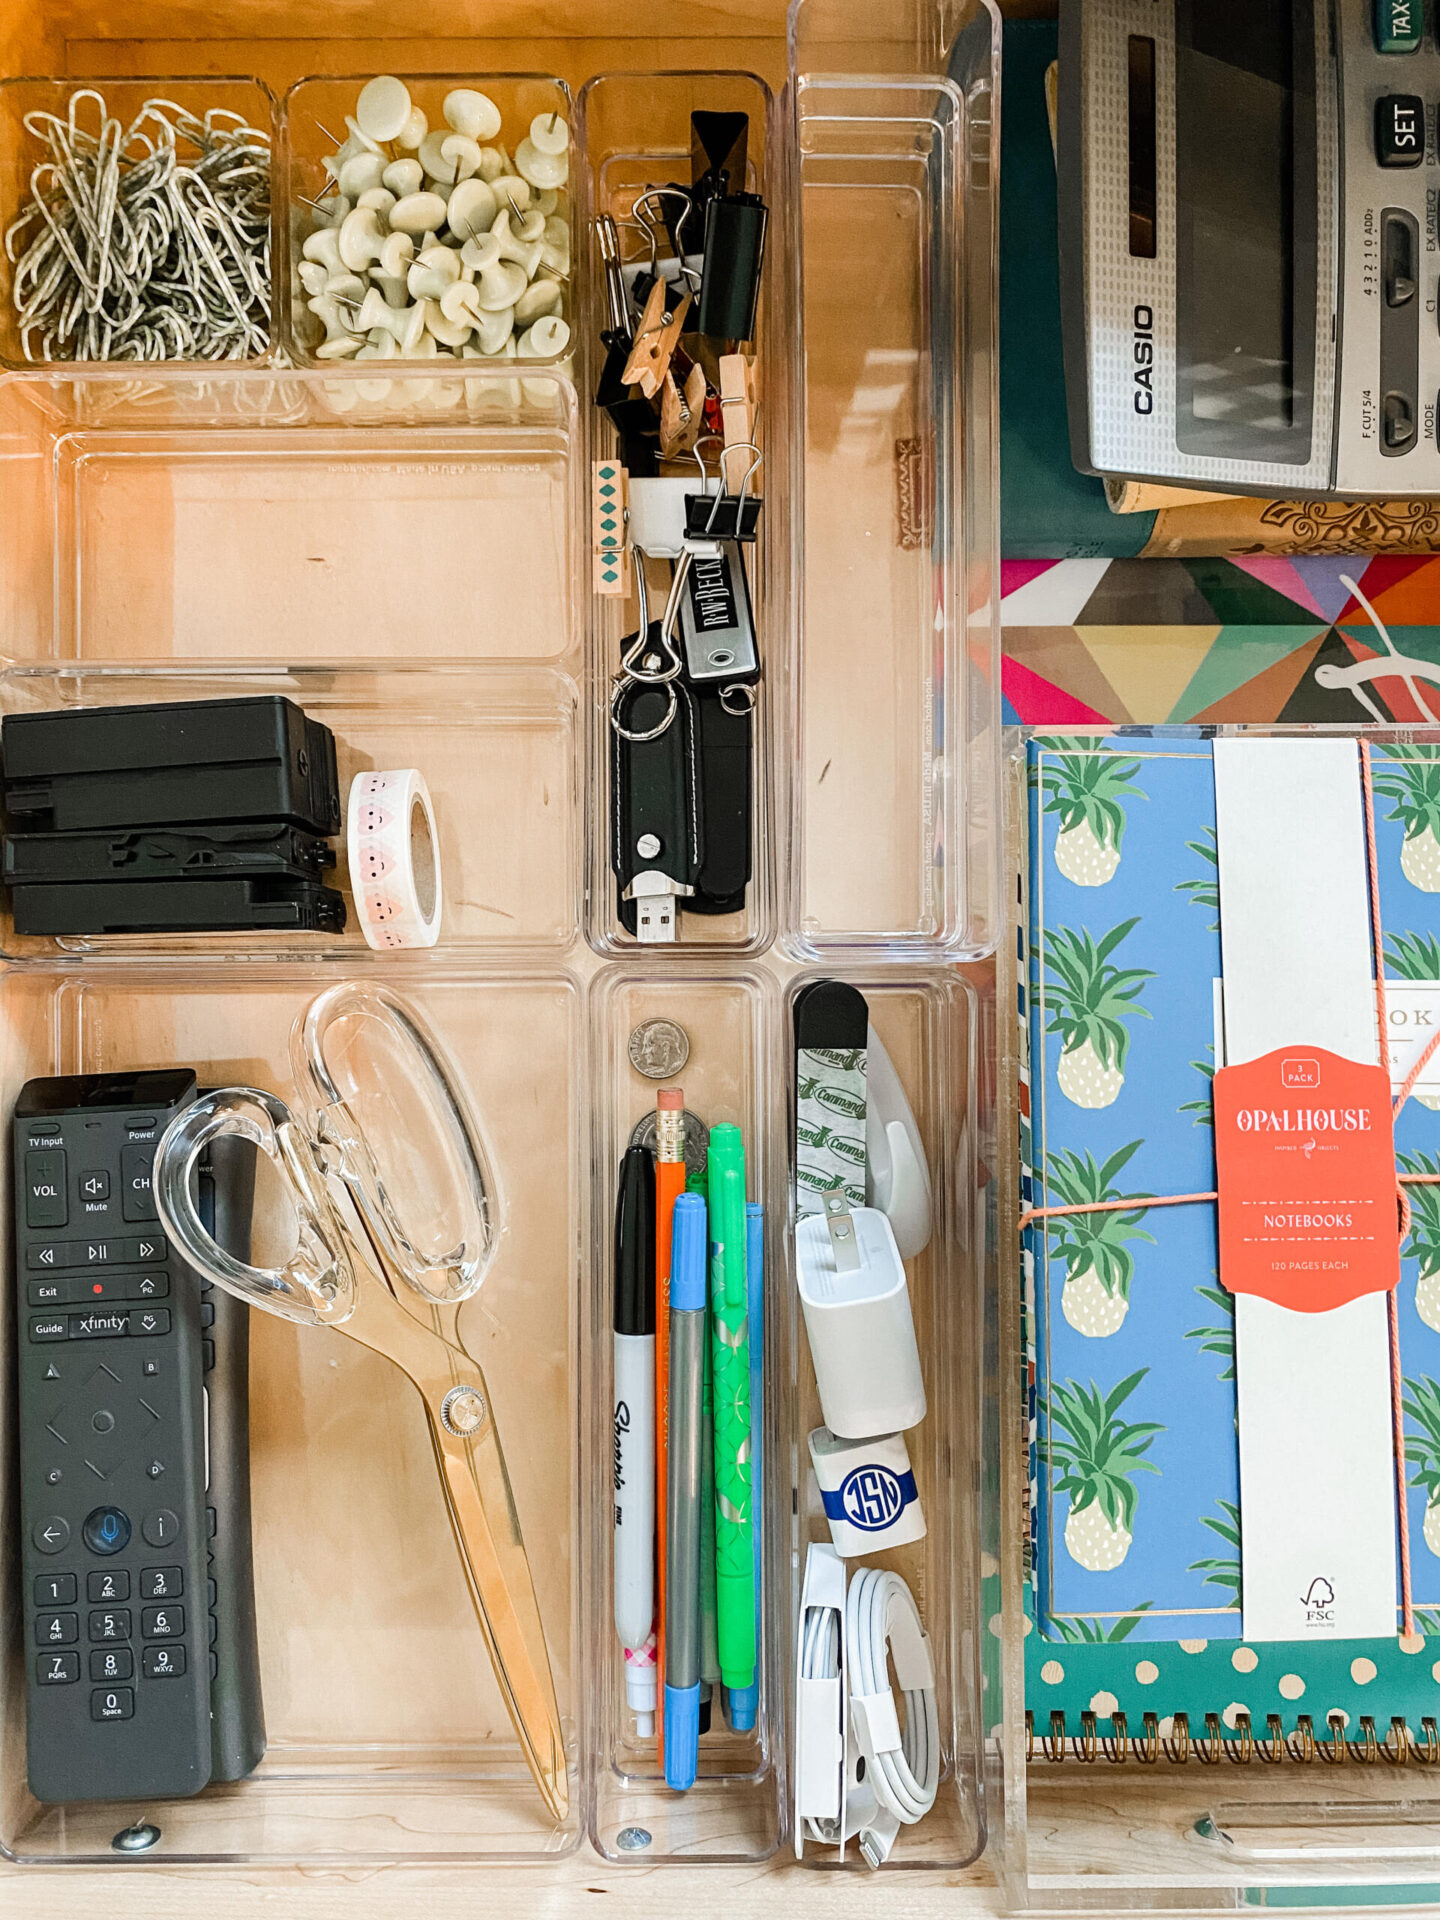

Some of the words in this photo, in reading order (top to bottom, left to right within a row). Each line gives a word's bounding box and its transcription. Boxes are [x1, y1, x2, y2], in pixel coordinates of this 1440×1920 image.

[1392, 0, 1411, 37] TAX
[1394, 104, 1416, 147] SET
[1425, 188, 1436, 233] RATE/C2
[1425, 234, 1436, 252] EX
[1425, 299, 1436, 313] C1
[1134, 305, 1153, 415] CASIO
[1362, 389, 1371, 409] 5/4
[1362, 410, 1371, 431] CUT
[1424, 403, 1435, 439] MODE
[1288, 1072, 1314, 1082] PACK
[817, 1088, 864, 1113] Command
[1236, 1108, 1372, 1132] OPALHOUSE
[29, 1138, 41, 1147] TV
[41, 1137, 64, 1147] Input
[129, 1130, 155, 1140] Power
[133, 1178, 150, 1189] CH
[33, 1186, 58, 1197] VOL
[86, 1202, 108, 1212] Mute
[1263, 1213, 1353, 1228] NOTEBOOKS
[1271, 1261, 1287, 1271] 120
[1289, 1261, 1320, 1270] PAGES
[1322, 1261, 1349, 1270] EACH
[39, 1287, 57, 1297] Exit
[142, 1286, 153, 1294] PG
[36, 1324, 63, 1334] Guide
[80, 1314, 128, 1333] xfinity
[47, 1368, 54, 1376] A
[148, 1363, 154, 1371] B
[50, 1472, 57, 1481] C
[151, 1465, 159, 1474] D
[103, 1576, 113, 1591] 2
[155, 1573, 164, 1588] 3
[51, 1583, 57, 1598] 1
[153, 1587, 168, 1595] DEF
[104, 1615, 114, 1630] 5
[156, 1612, 166, 1626] 6
[1305, 1610, 1335, 1621] FSC
[50, 1619, 61, 1633] 4
[153, 1626, 171, 1634] MNO
[49, 1632, 62, 1640] GHI
[52, 1658, 62, 1673] 7
[105, 1655, 116, 1669] 8
[158, 1651, 168, 1666] 9
[48, 1671, 67, 1679] PQRS
[104, 1668, 118, 1676] TUV
[153, 1665, 174, 1673] WXYZ
[106, 1694, 117, 1708] 0
[102, 1708, 122, 1716] Space
